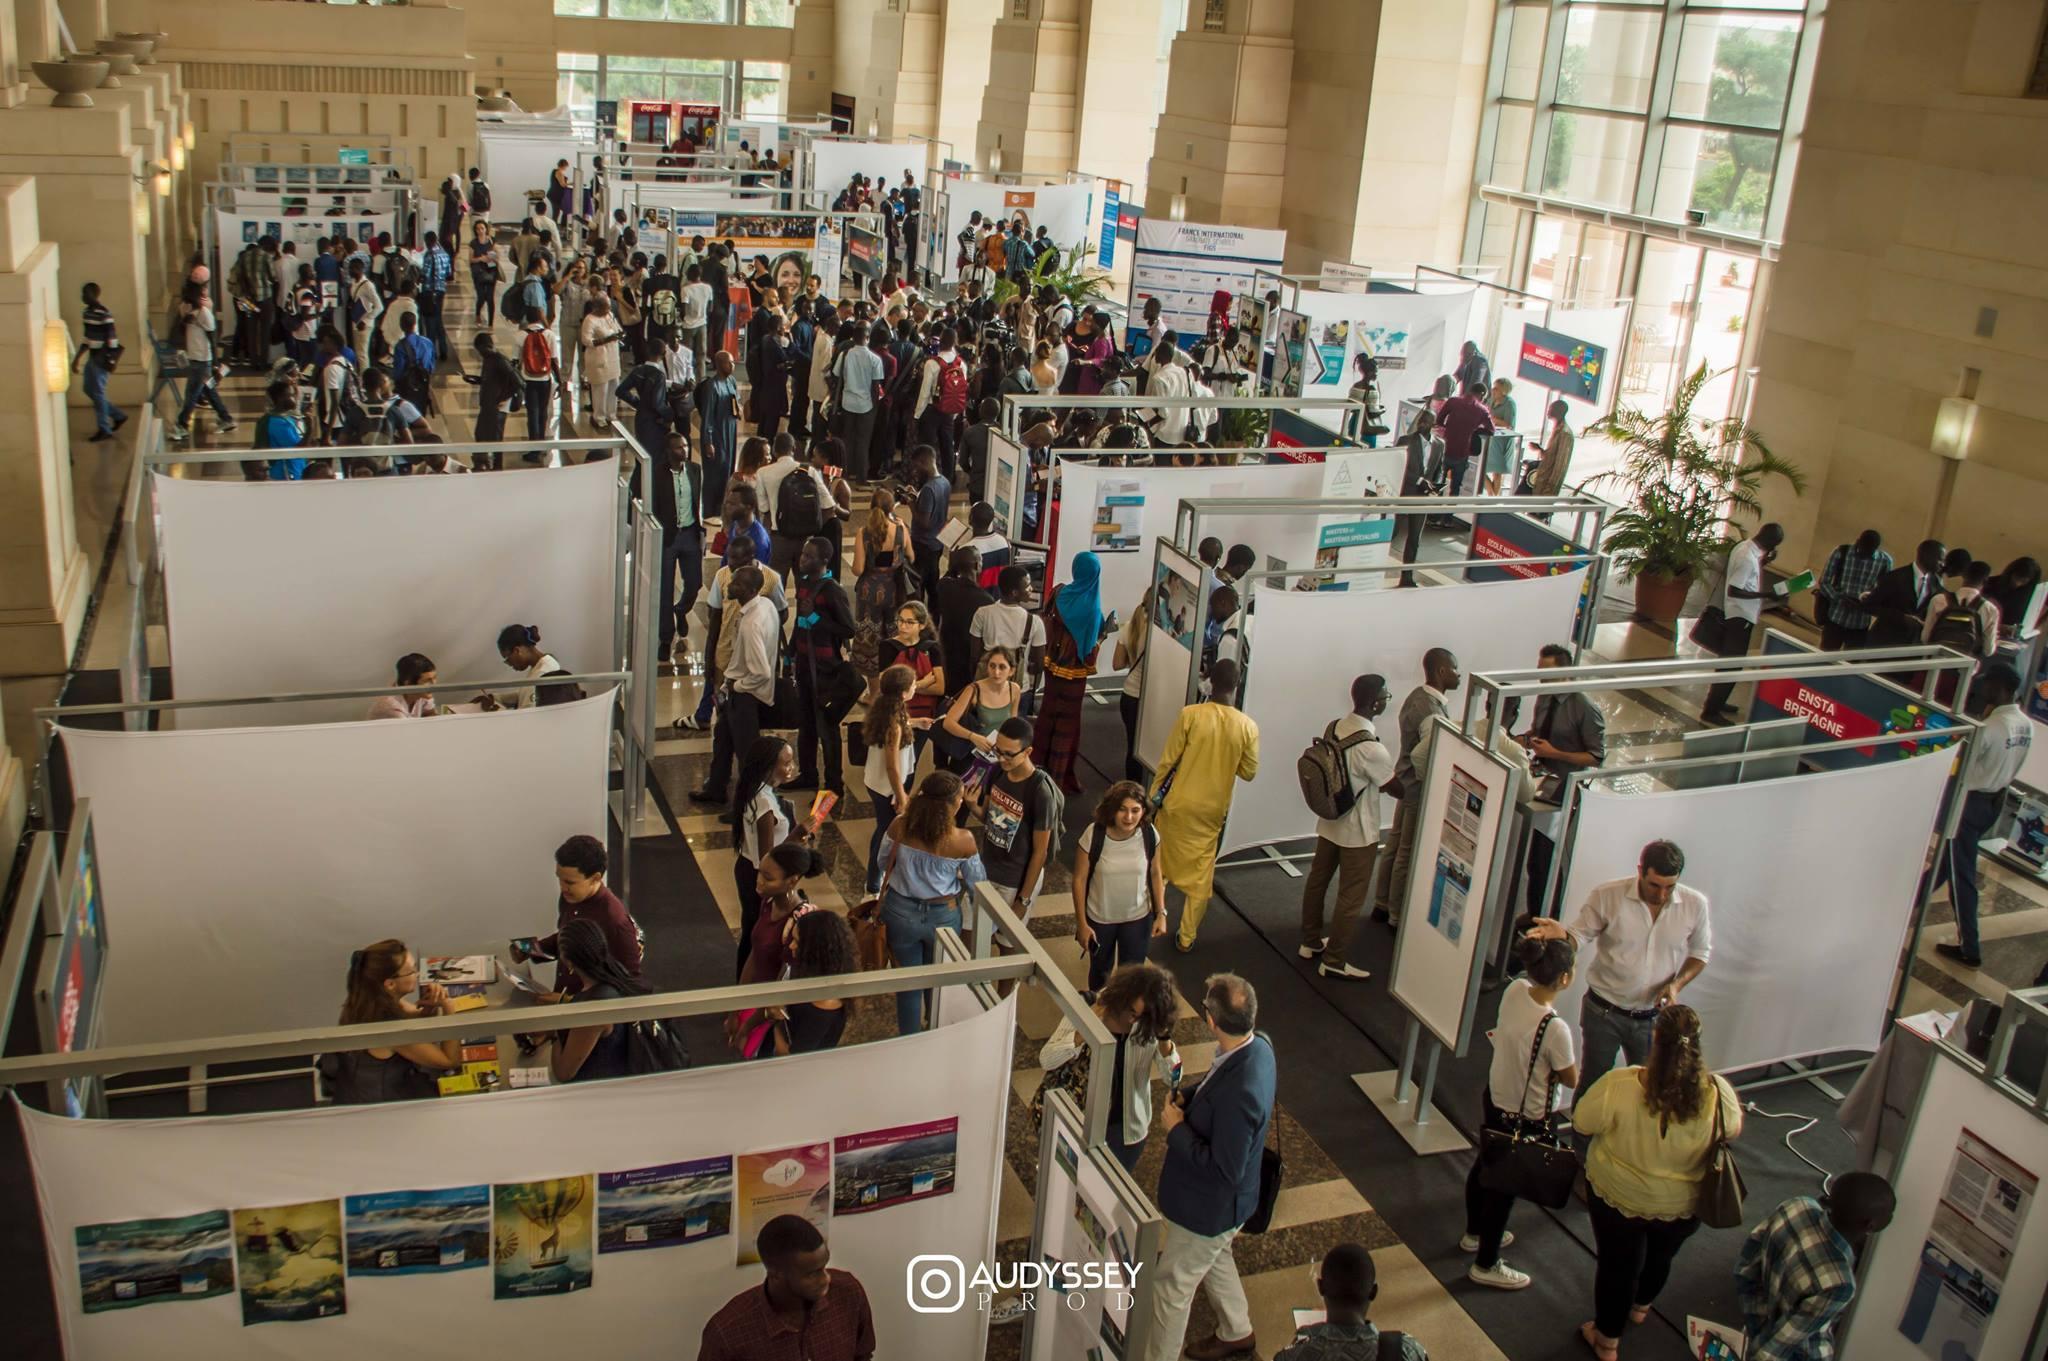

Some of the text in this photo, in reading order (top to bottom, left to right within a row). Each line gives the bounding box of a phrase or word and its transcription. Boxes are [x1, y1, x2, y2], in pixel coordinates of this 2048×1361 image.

[1178, 227, 1244, 241] FRANCE INTERNATIONAL
[1545, 361, 1565, 374] SCHOOL
[1475, 543, 1486, 554] DES
[1487, 538, 1503, 553] ECOLE
[1798, 688, 1836, 716] ENSTA
[1783, 698, 1845, 738] BRETAGNE
